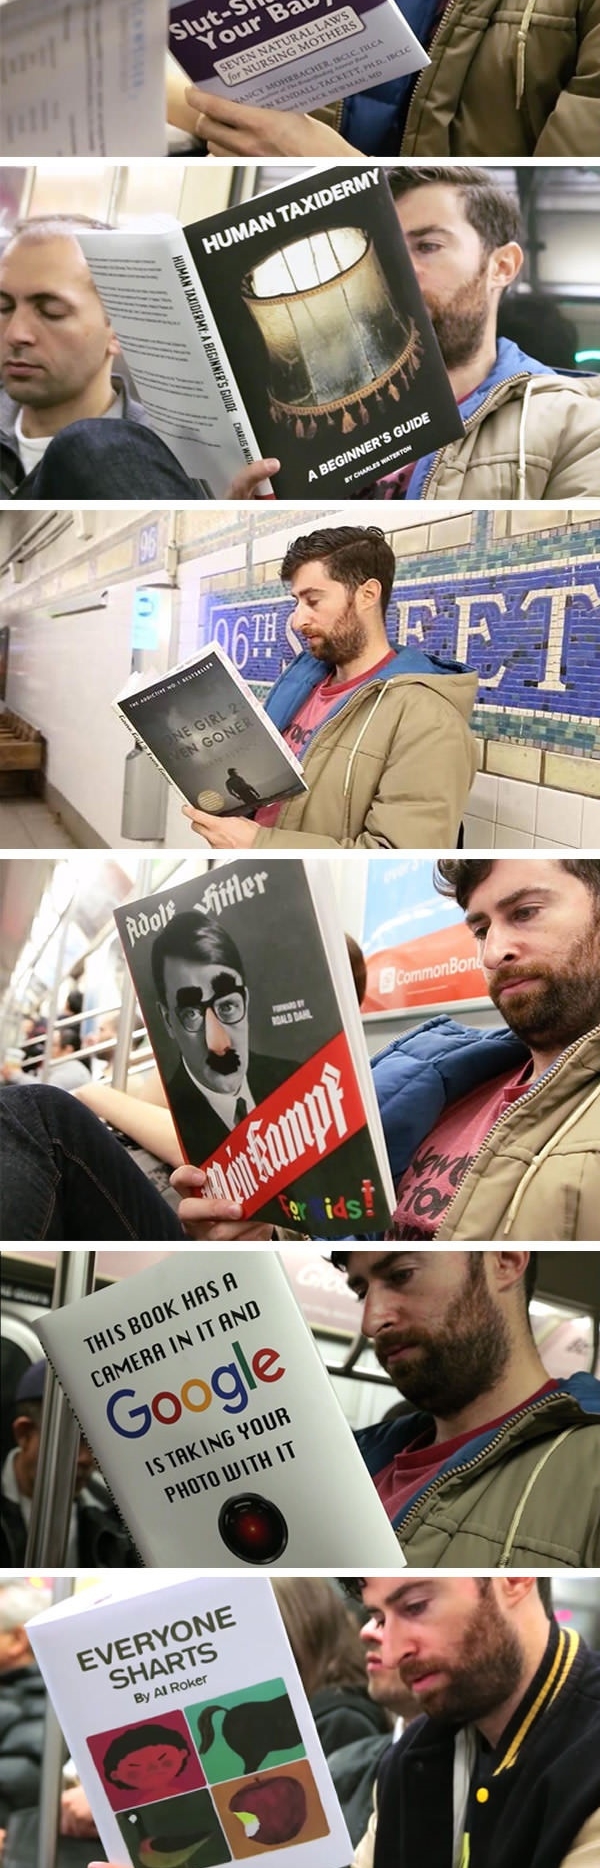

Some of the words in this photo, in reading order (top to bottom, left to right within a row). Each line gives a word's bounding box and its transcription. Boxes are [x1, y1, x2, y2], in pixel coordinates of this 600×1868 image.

[196, 16, 262, 51] Your
[201, 213, 277, 254] HUMAN
[276, 167, 380, 223] TAXIDERMY
[139, 528, 156, 564] 96
[193, 871, 269, 917] Hitler
[248, 1062, 345, 1182] Kampf
[83, 1324, 126, 1354] THIS
[127, 1298, 180, 1336] BOOK
[181, 1280, 220, 1311] HAS
[222, 1272, 239, 1292] A
[90, 1342, 167, 1388] CAMERA
[168, 1330, 194, 1354] IN
[196, 1319, 216, 1342] IT
[217, 1300, 261, 1333] AND
[106, 1340, 286, 1439] Google
[145, 1457, 166, 1477] IS
[164, 1429, 235, 1468] TAKING
[236, 1407, 292, 1441] YOUR
[163, 1470, 221, 1503] PHOTO
[221, 1450, 273, 1483] WITH
[275, 1440, 296, 1463] IT
[76, 1605, 237, 1672] EVERYONE
[109, 1642, 218, 1690] SHARTS
[134, 1692, 150, 1704] By
[154, 1685, 168, 1699] Al
[169, 1674, 208, 1693] Roker
